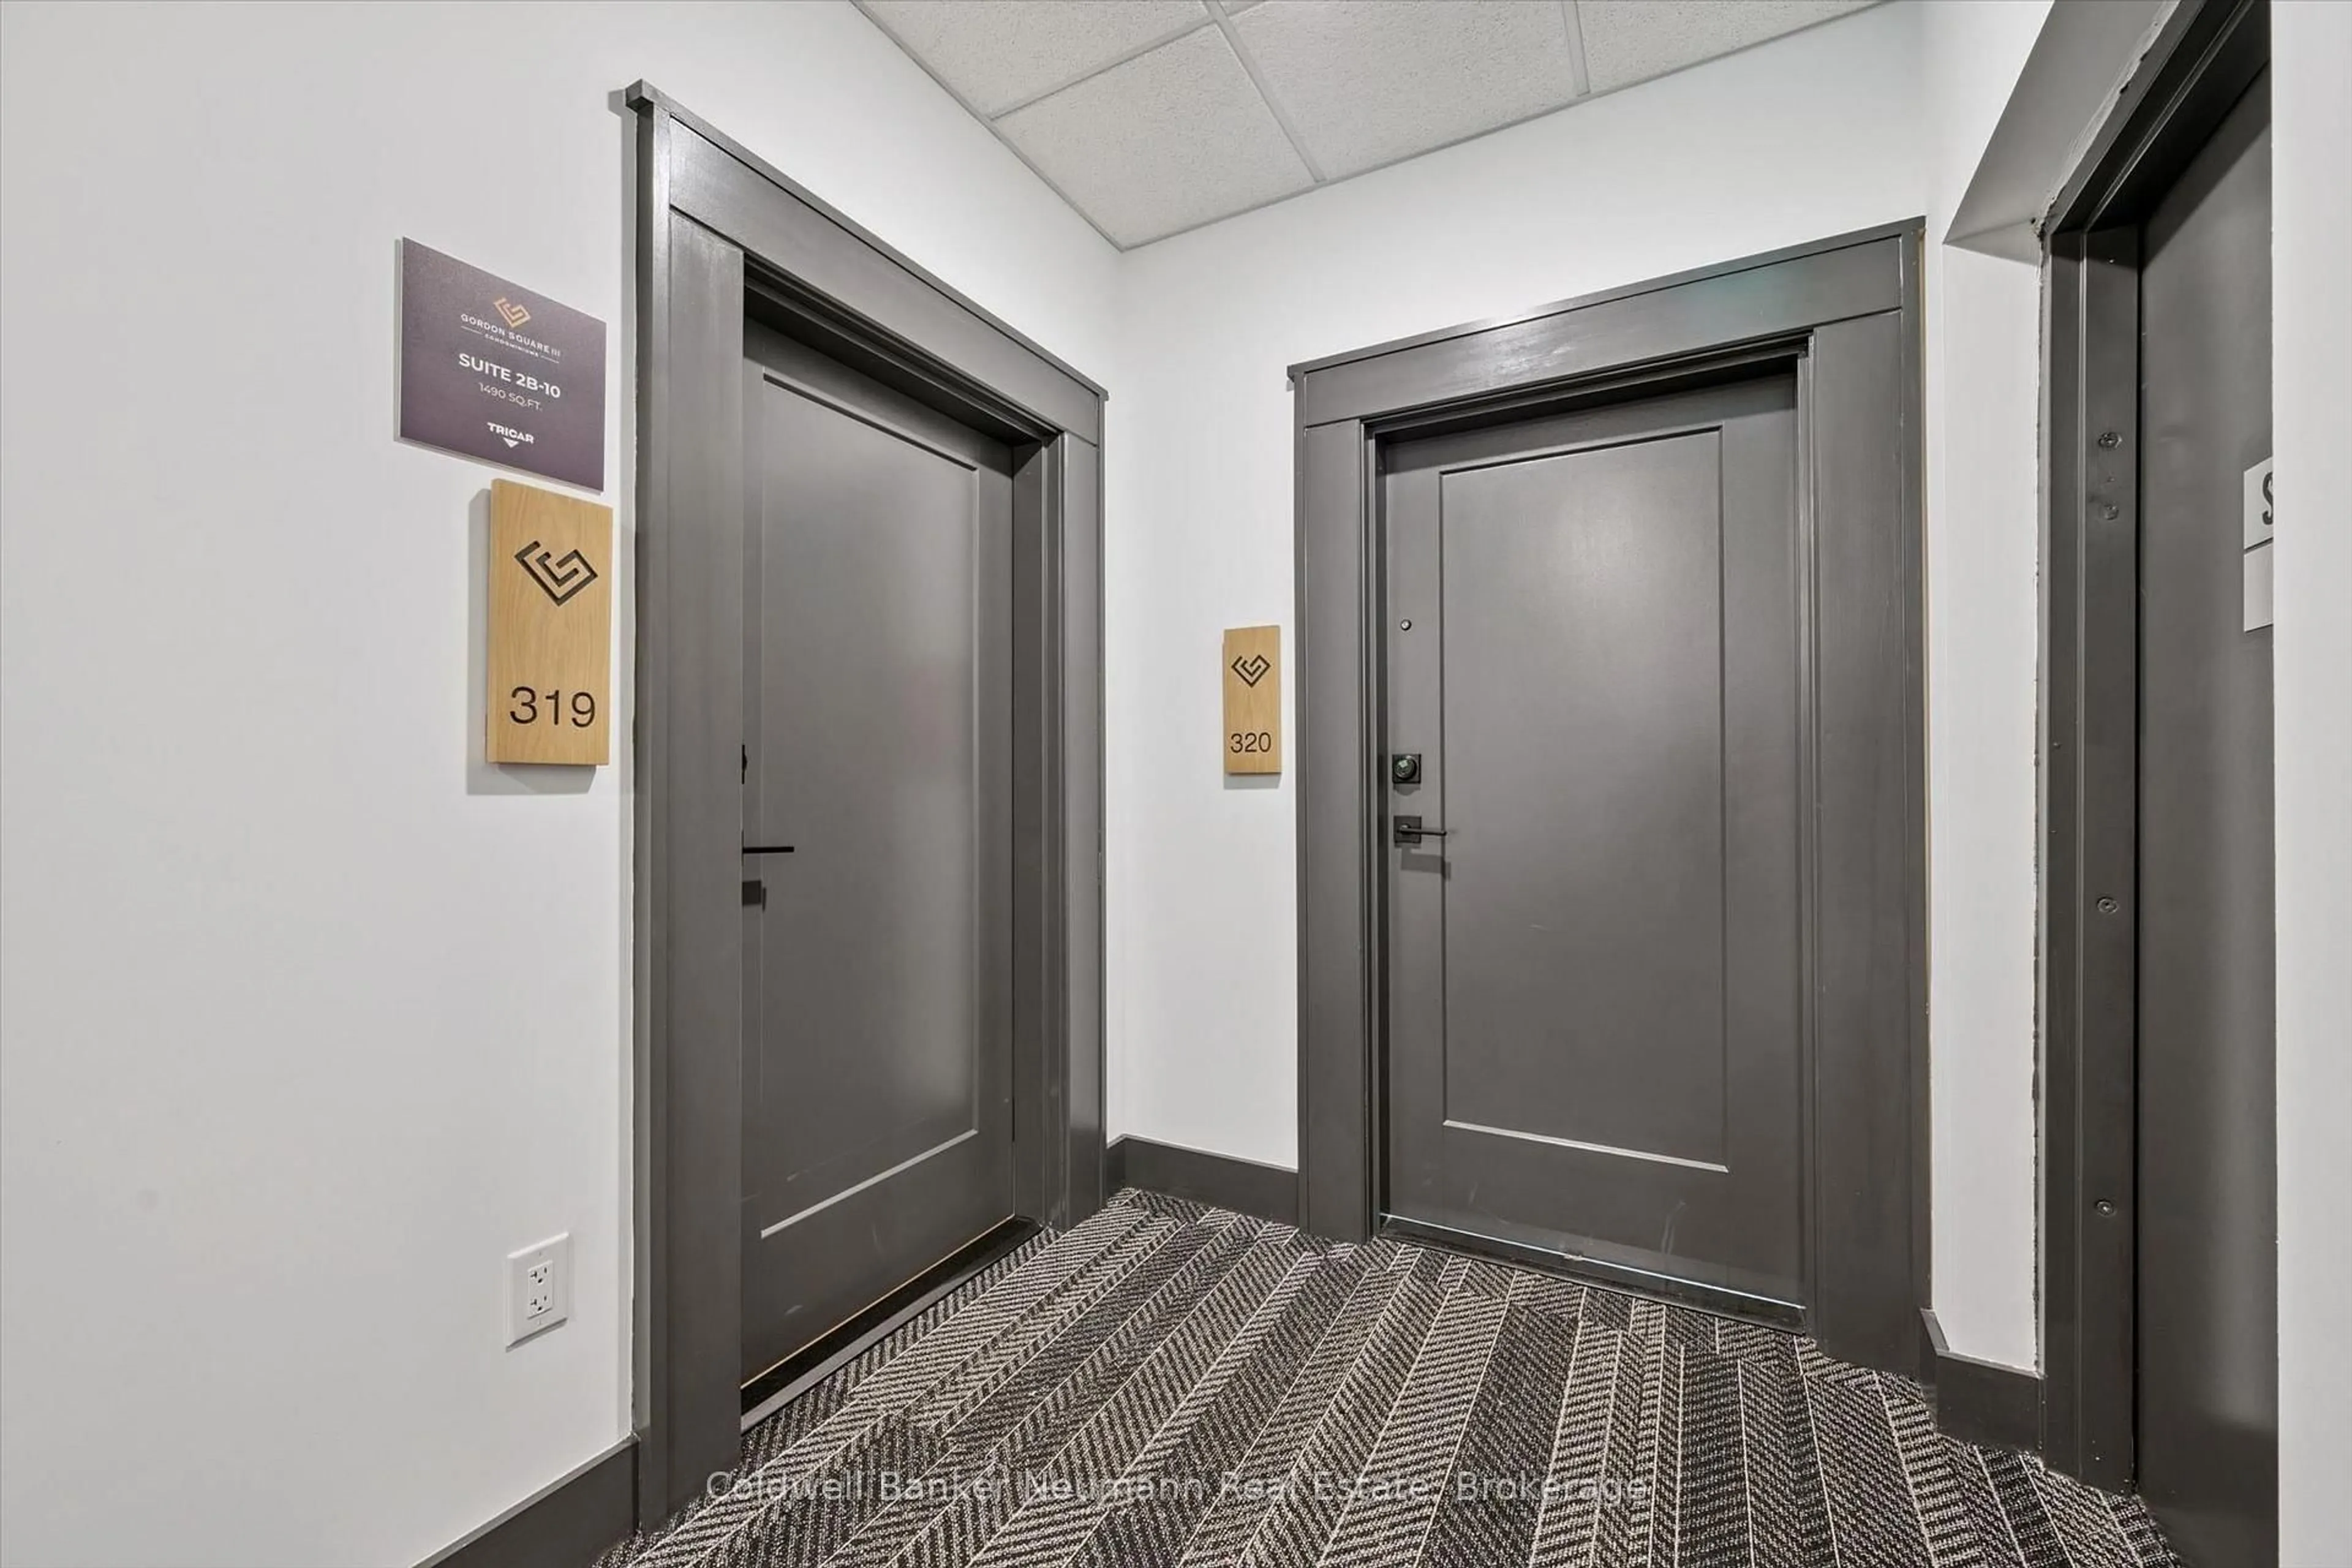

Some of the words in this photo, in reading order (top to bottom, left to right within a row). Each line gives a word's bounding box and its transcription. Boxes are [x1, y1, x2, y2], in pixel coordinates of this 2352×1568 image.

[461, 314, 505, 336] GORDON
[508, 332, 549, 353] SQUARE
[459, 353, 511, 382] SUITE
[516, 373, 561, 398] 2B-10
[478, 382, 506, 399] 1490
[487, 422, 535, 444] TRICAR
[510, 686, 596, 728] 319
[1231, 732, 1272, 753] 320
